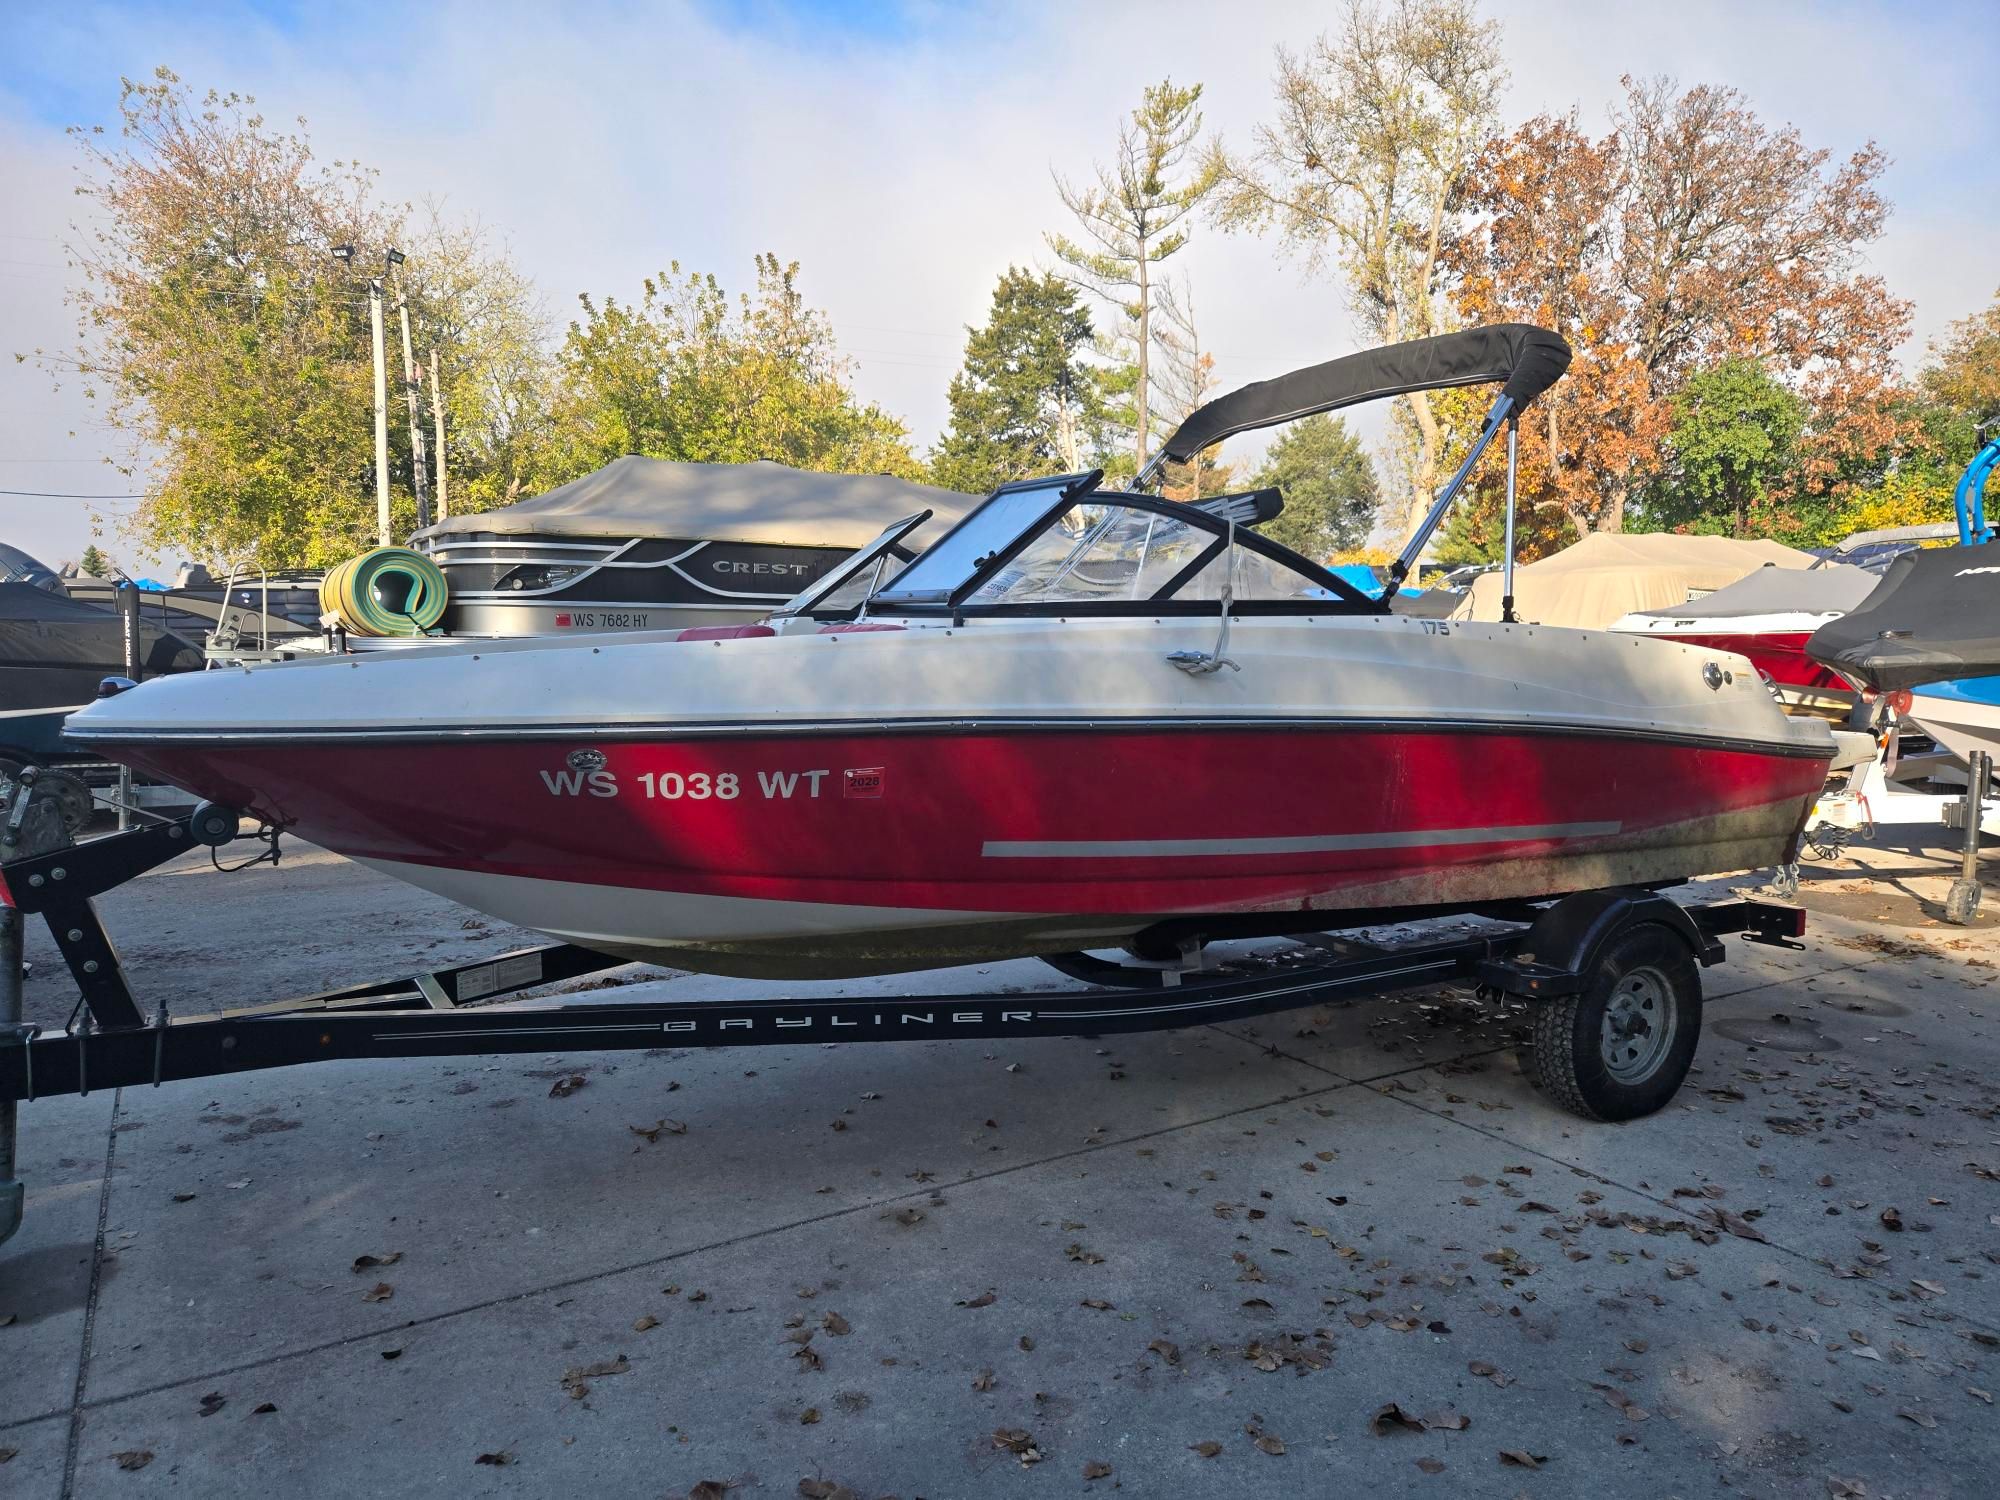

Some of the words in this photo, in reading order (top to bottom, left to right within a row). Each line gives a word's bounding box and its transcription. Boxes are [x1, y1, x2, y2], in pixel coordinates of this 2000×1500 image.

[712, 560, 809, 576] CREST
[573, 613, 594, 627] WS
[600, 614, 630, 627] 7682
[633, 614, 648, 627] HY
[1420, 620, 1450, 636] 175
[540, 769, 619, 798] WS
[637, 772, 740, 800] 1038
[757, 769, 830, 799] WT
[663, 1010, 1033, 1032] BAYLINER
